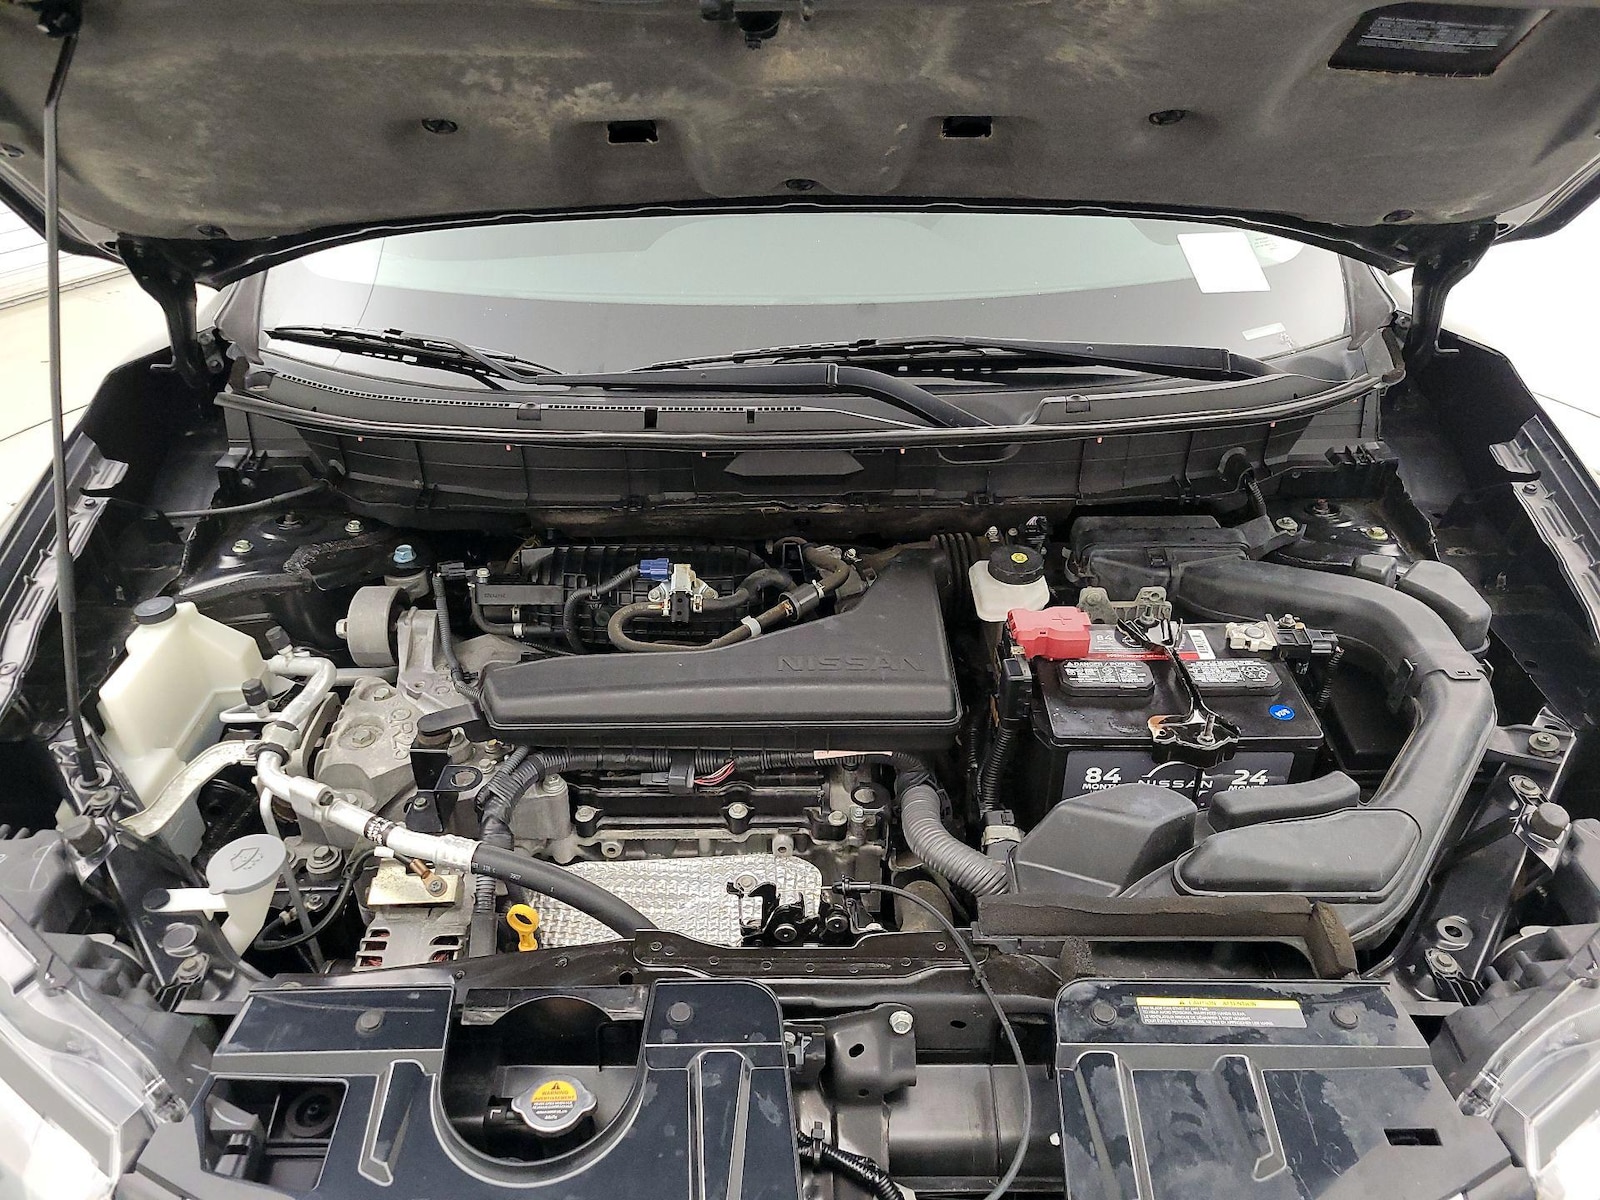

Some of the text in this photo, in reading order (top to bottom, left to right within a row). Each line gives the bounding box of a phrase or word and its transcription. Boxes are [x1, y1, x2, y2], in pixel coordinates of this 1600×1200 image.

[777, 656, 925, 671] NISSAN
[1085, 767, 1121, 783] 84
[1231, 769, 1268, 785] 24
